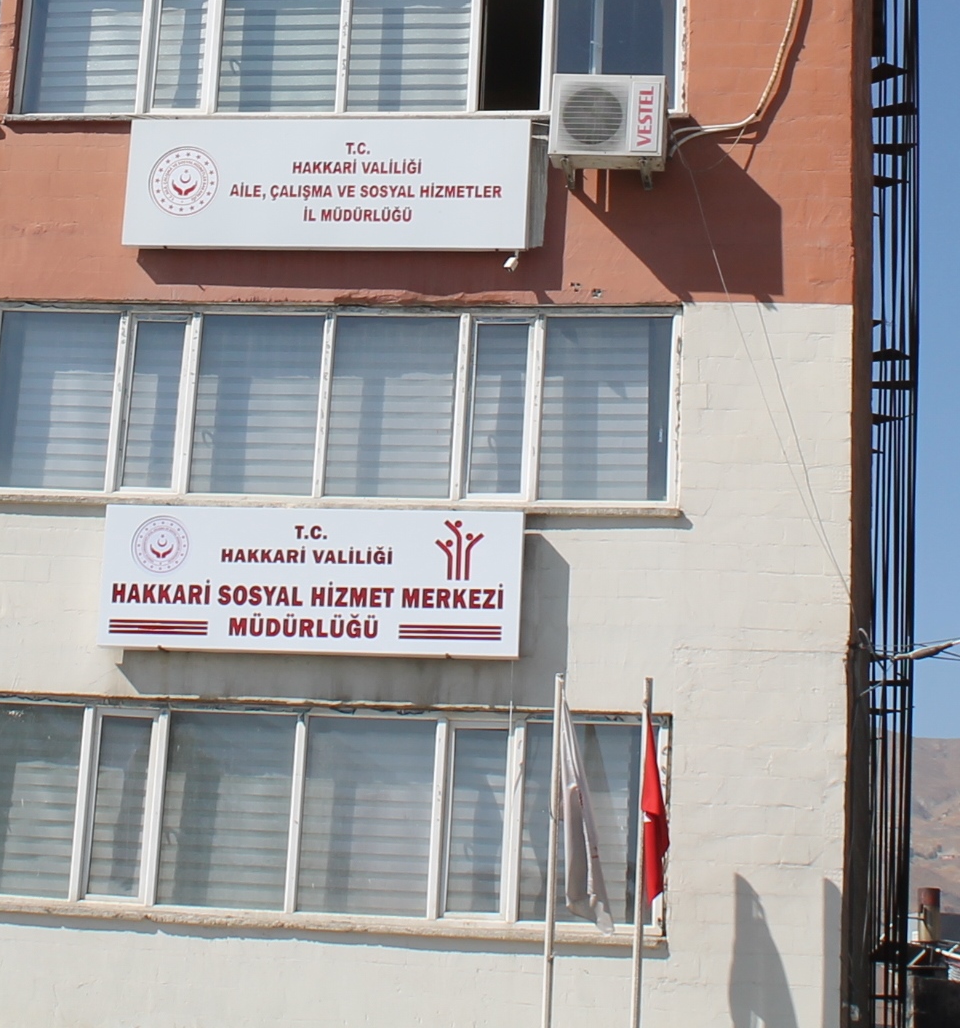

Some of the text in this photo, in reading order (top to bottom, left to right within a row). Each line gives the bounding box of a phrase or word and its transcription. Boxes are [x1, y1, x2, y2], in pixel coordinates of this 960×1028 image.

[637, 86, 654, 147] VESTEL
[345, 142, 371, 155] T.C.
[292, 158, 422, 174] HAKKARİ VALİLİĞİ
[229, 182, 502, 201] AİLE, ÇALIŞMA VE SOSYAL HİZMETLER
[303, 206, 412, 222] İL MÜDÜRLÜĞÜ
[294, 525, 328, 540] T.C.
[221, 546, 394, 565] HAKKARİ VALİLİĞİ
[111, 579, 504, 610] HAKKARİ SOSYAL HİZMET MERKEZİ
[228, 612, 379, 639] MÜDÜRLÜĞÜ
